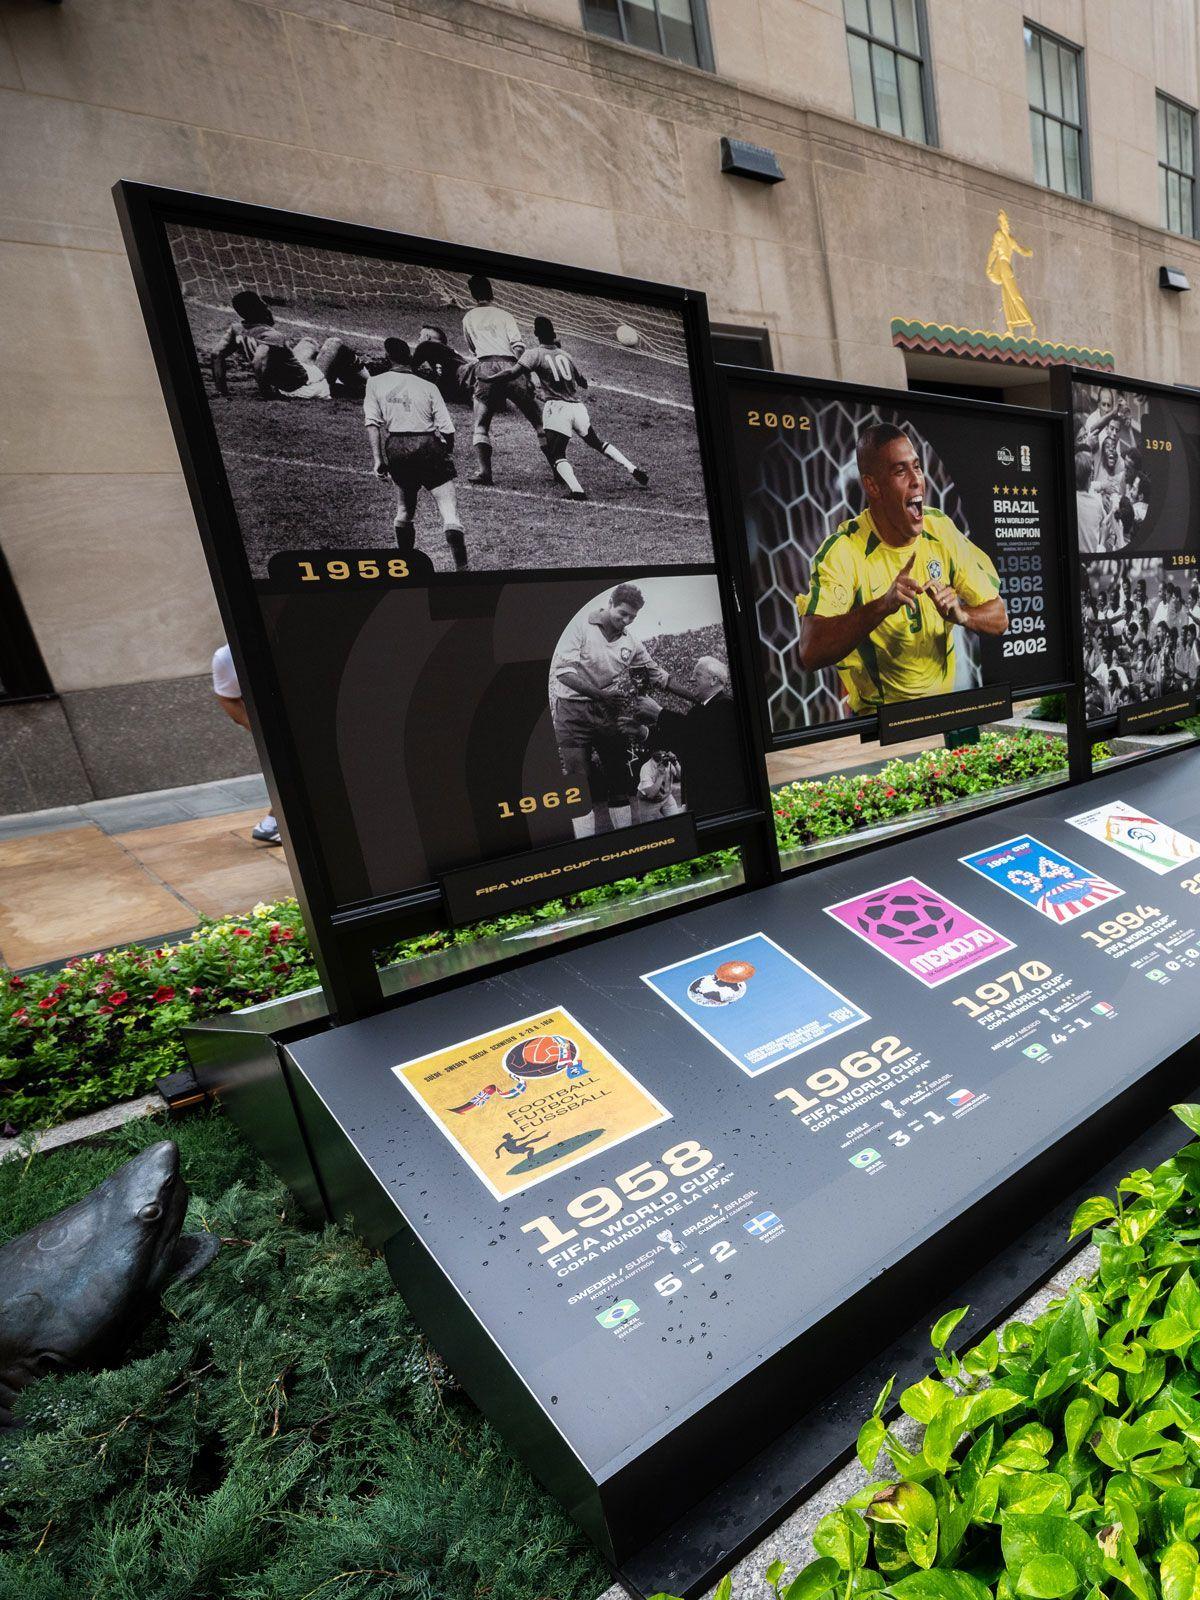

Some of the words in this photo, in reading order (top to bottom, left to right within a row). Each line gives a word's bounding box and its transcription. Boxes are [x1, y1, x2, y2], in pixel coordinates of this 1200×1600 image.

[545, 353, 573, 382] 10
[748, 411, 810, 430] 2002
[1146, 439, 1172, 451] 1970
[993, 500, 1039, 514] BRAZIL
[995, 527, 1041, 538] CHAMPION
[298, 559, 410, 581] 1958
[997, 555, 1042, 572] 1958
[1171, 556, 1197, 566] 1994
[1000, 575, 1043, 594] 1962
[1002, 637, 1047, 657] 2002
[498, 787, 582, 819] 1962
[475, 882, 509, 897] FIFA
[511, 868, 561, 887] WORLD
[601, 836, 676, 862] CHAMPIONS
[1081, 905, 1162, 948] 1994
[1104, 942, 1126, 955] FIFA
[1123, 926, 1154, 943] WORLD
[909, 935, 976, 974] MEXICO
[966, 929, 996, 955] 70
[1165, 961, 1181, 971] 0
[1185, 948, 1200, 958] 0
[952, 961, 1052, 1018] 1970
[977, 1010, 1005, 1026] FIFA
[1002, 988, 1042, 1010] WORLD
[987, 1017, 1009, 1030] COPA
[1007, 1000, 1039, 1019] MUNDIAL
[991, 1034, 1015, 1051] MEXICO
[1051, 1033, 1067, 1044] 4
[1074, 1018, 1092, 1029] 1
[444, 1059, 468, 1073] SWEDEN
[774, 1036, 913, 1115] 1962
[507, 1077, 600, 1118] FOOTBALL
[513, 1093, 585, 1125] FUTBOL
[519, 1090, 612, 1132] FUSSBALL
[801, 1104, 839, 1126] FIFA
[836, 1073, 890, 1104] WORLD
[810, 1114, 840, 1132] COPA
[839, 1090, 883, 1116] MUNDIAL
[882, 1081, 896, 1091] DE
[895, 1074, 909, 1083] LA
[900, 1090, 926, 1106] BRAZIL
[846, 1122, 870, 1138] CHILE
[888, 1130, 910, 1147] 3
[923, 1111, 945, 1125] 1
[520, 1141, 713, 1254] 1958
[682, 1214, 718, 1236] BRAZIL
[724, 1190, 758, 1211] BRASIL
[698, 1217, 726, 1235] CHAMPION
[547, 1237, 600, 1269] FIFA
[600, 1192, 678, 1237] WORLD
[557, 1252, 599, 1277] COPA
[600, 1216, 664, 1253] MUNDIAL
[664, 1203, 683, 1216] DE
[683, 1193, 702, 1205] LA
[759, 1224, 784, 1241] SWEDEN
[568, 1273, 617, 1305] SWEDEN
[625, 1246, 665, 1270] SUECIA
[654, 1273, 682, 1297] 5
[710, 1241, 737, 1263] 2
[682, 1257, 699, 1268] FINAL
[590, 1288, 607, 1300] HOST
[613, 1317, 640, 1335] BRAZIL
